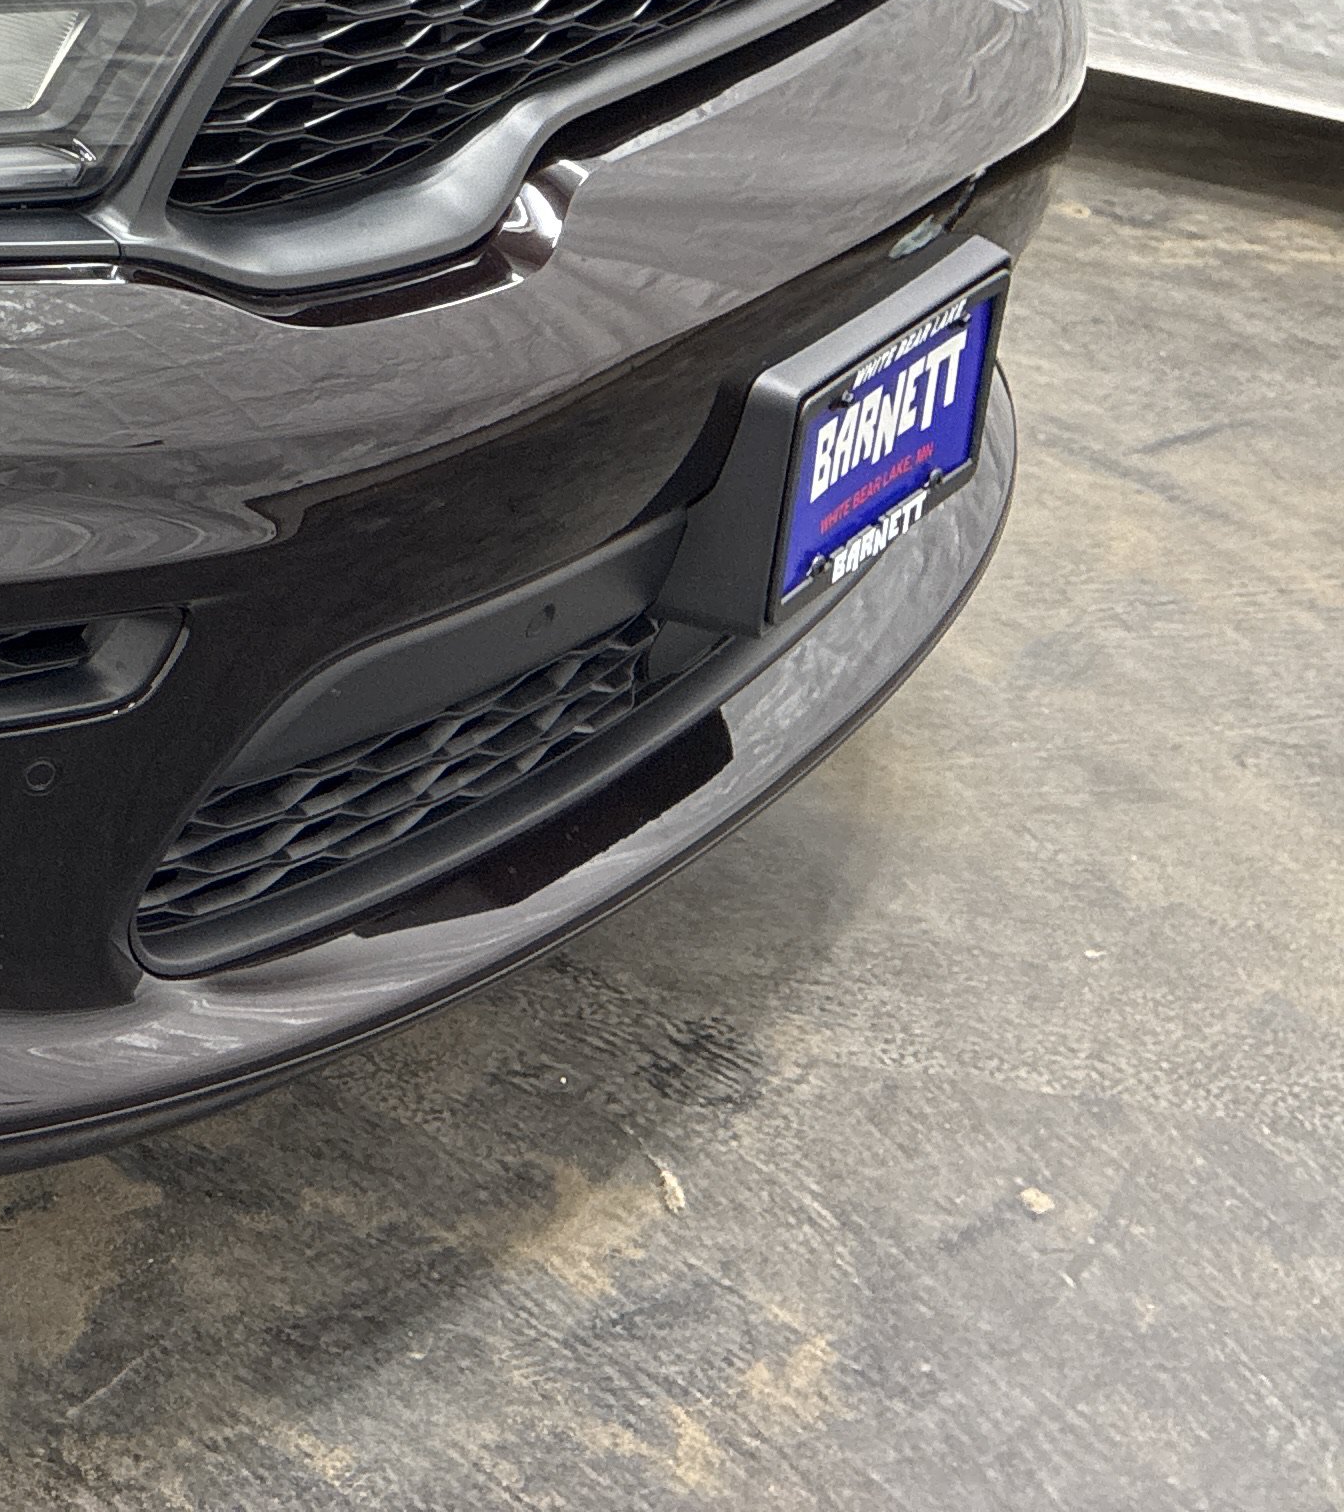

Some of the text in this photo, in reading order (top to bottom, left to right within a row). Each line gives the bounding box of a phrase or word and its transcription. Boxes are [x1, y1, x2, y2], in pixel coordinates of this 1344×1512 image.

[853, 298, 968, 390] WHITE BEAR LAKE
[810, 329, 968, 503] BARNETT
[820, 497, 851, 535] WHITE
[831, 490, 928, 584] BARNETT
